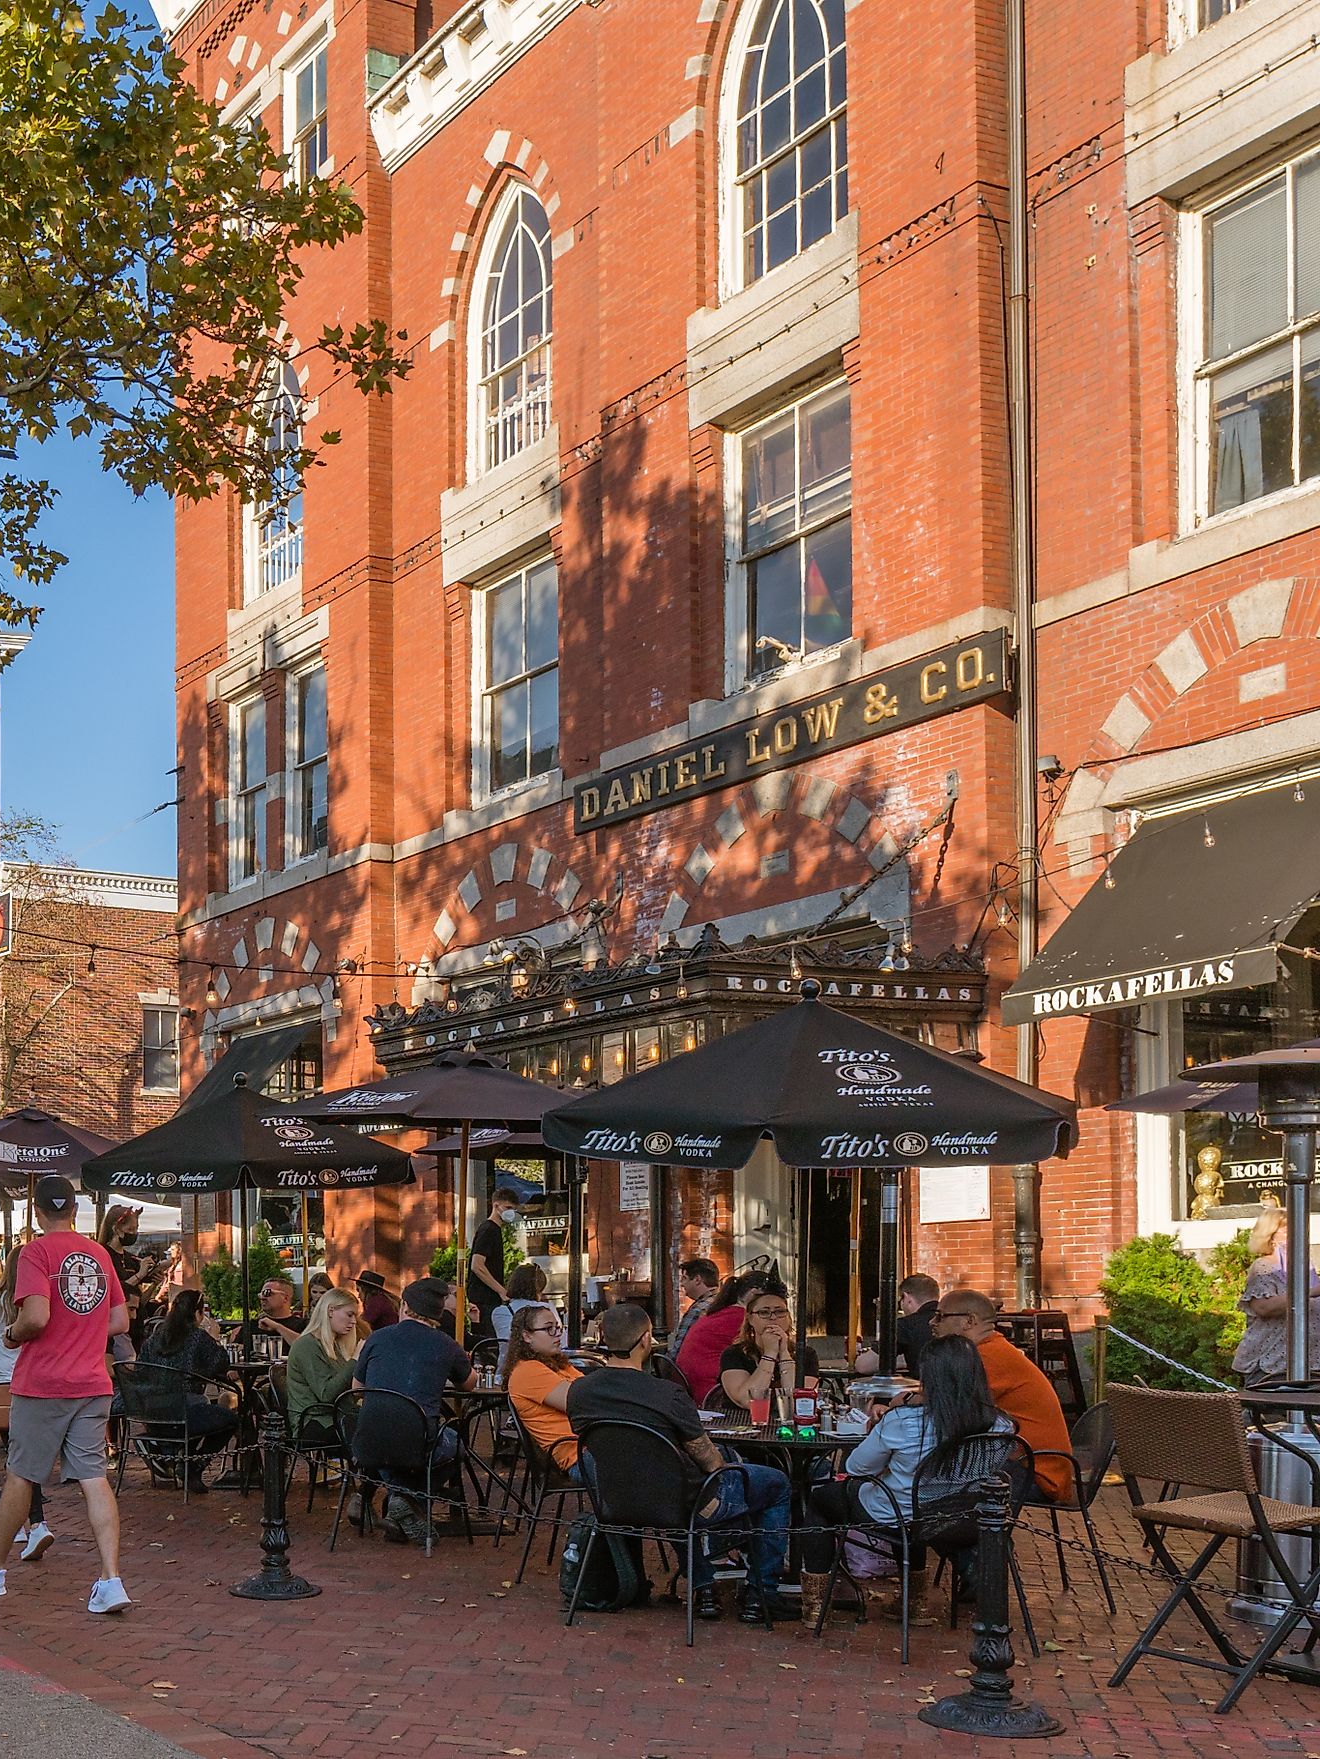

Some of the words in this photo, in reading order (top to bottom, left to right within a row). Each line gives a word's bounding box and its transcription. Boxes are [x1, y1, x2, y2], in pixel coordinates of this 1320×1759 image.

[580, 744, 726, 823] DANIEL
[745, 697, 843, 767] LOW
[863, 682, 898, 725] &
[920, 646, 996, 705] CO.
[726, 977, 971, 1001] ROCAFELLAS
[1032, 960, 1234, 1016] ROCKAFELLAS
[403, 987, 661, 1050] ROCKAFELLAS
[837, 1085, 932, 1096] Handmade
[279, 1138, 334, 1148] Handmade
[674, 1133, 722, 1148] Handmade
[931, 1131, 999, 1147] Handmade
[679, 1148, 713, 1158] VODKA
[940, 1146, 990, 1156] VODKA
[178, 1171, 215, 1182] Handmade
[340, 1165, 378, 1178] Handmade
[346, 1175, 375, 1183] VODKA
[64, 1255, 98, 1270] ALASKA
